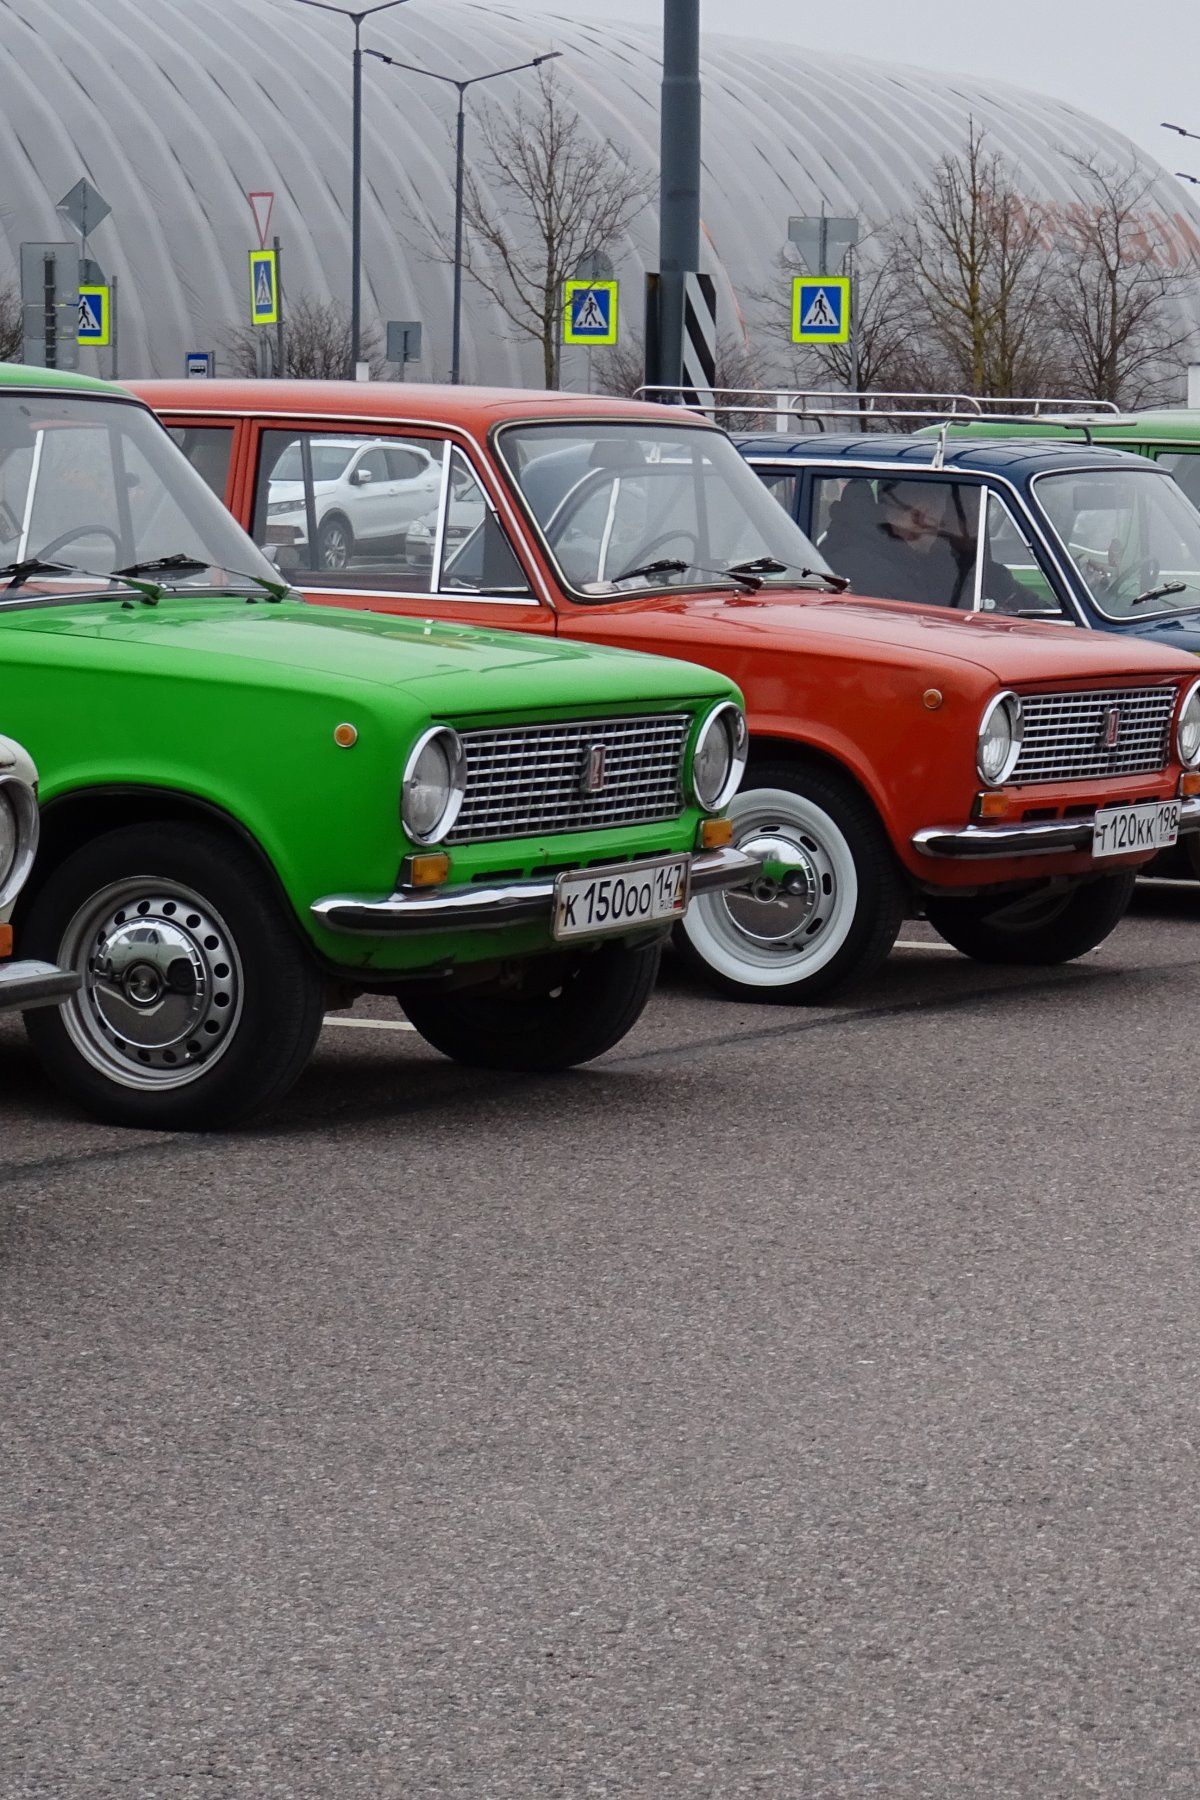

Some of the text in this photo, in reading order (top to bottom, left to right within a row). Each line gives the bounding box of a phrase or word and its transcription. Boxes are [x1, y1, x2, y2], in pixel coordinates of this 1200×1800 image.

[1100, 805, 1178, 851] Т120КК 198
[656, 864, 682, 900] 147
